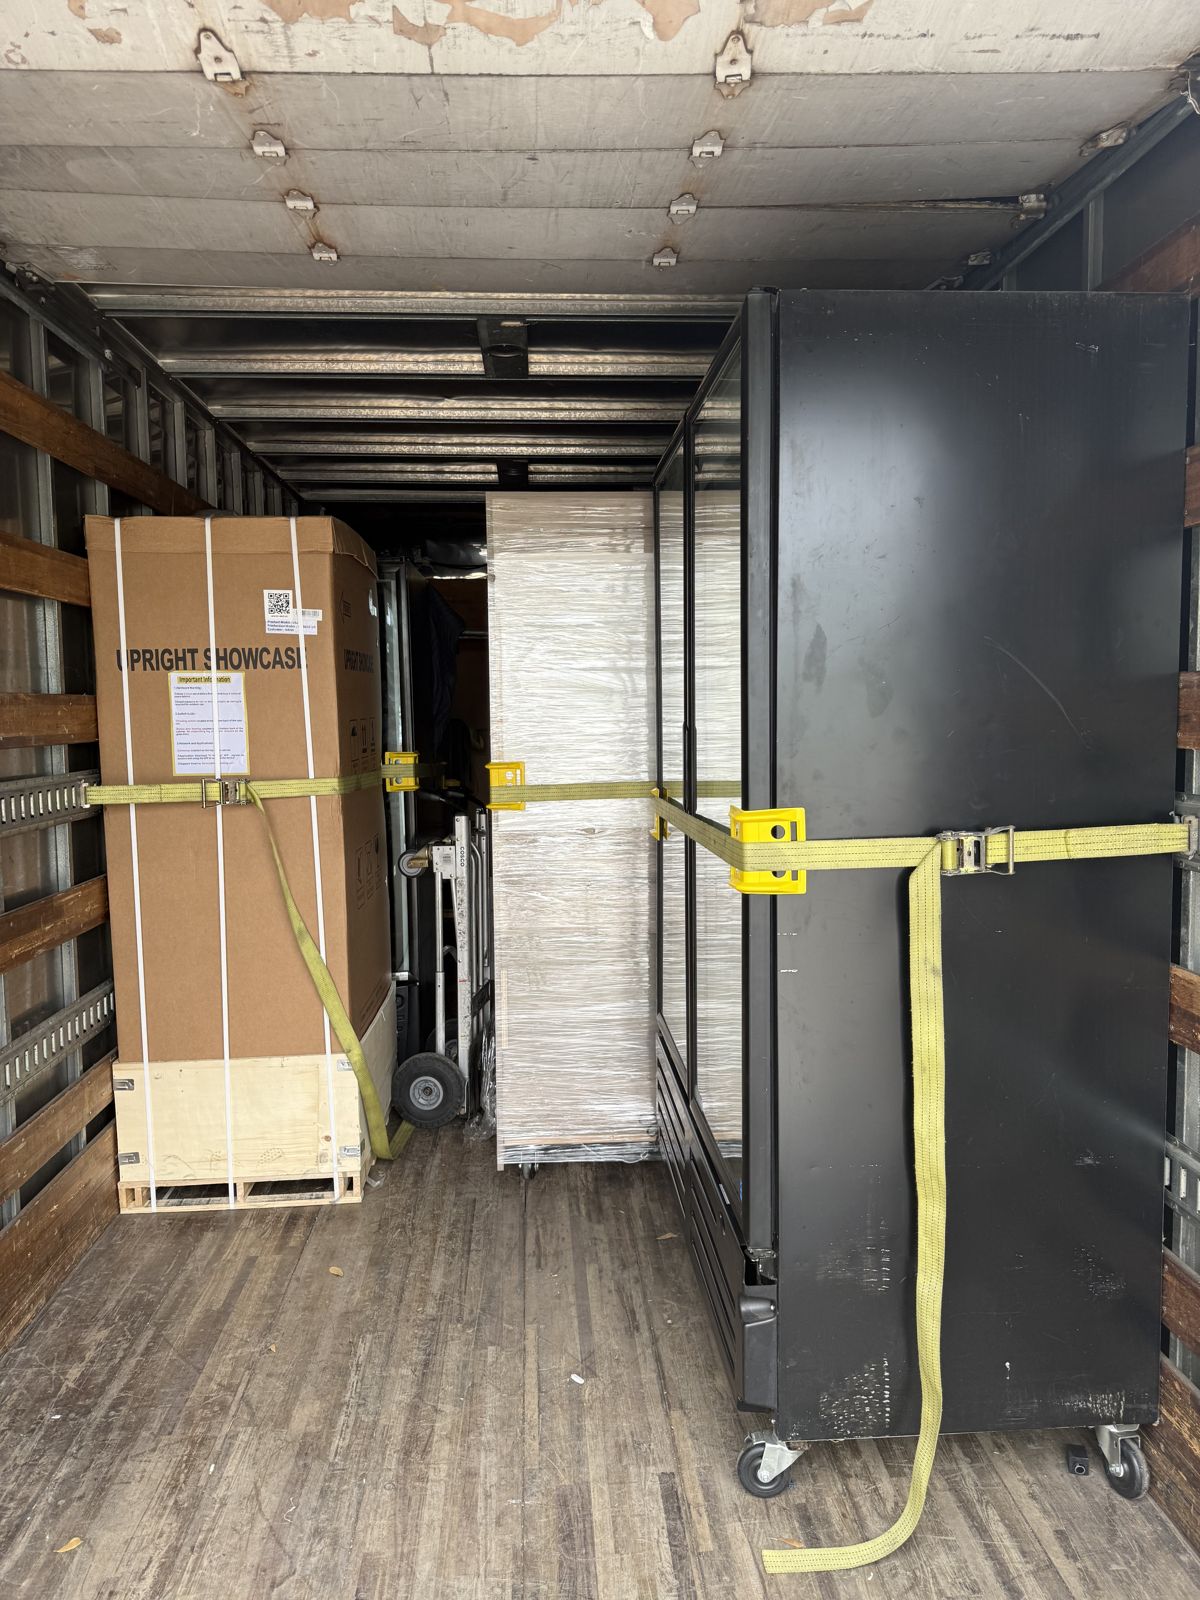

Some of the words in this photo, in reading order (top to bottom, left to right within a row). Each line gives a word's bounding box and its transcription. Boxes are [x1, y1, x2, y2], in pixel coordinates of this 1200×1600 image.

[116, 648, 199, 672] UPRIGHT
[179, 675, 203, 684] Important
[203, 674, 231, 683] Infoation
